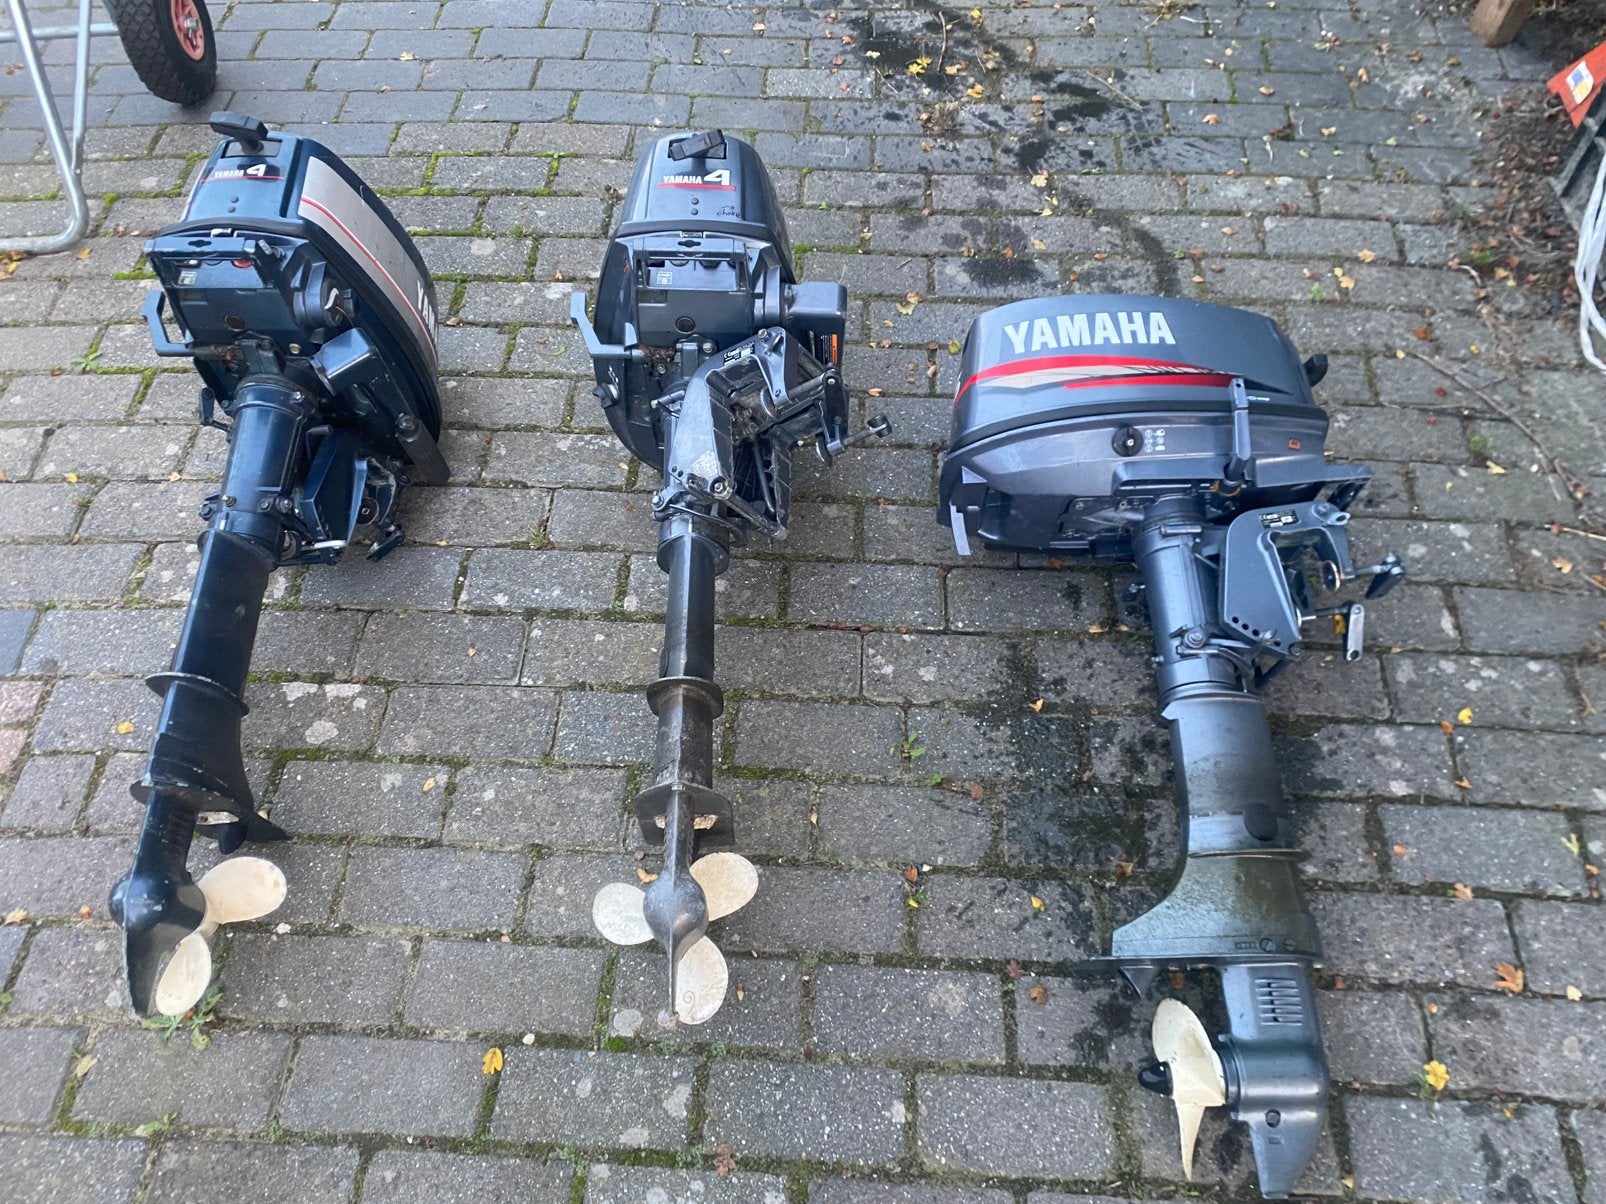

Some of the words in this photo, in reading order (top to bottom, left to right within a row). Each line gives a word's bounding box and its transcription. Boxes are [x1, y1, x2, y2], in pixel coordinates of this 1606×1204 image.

[246, 163, 267, 177] 4
[663, 175, 703, 184] YAMAHA
[704, 169, 731, 186] 4
[1003, 311, 1177, 355] YAMAHA
